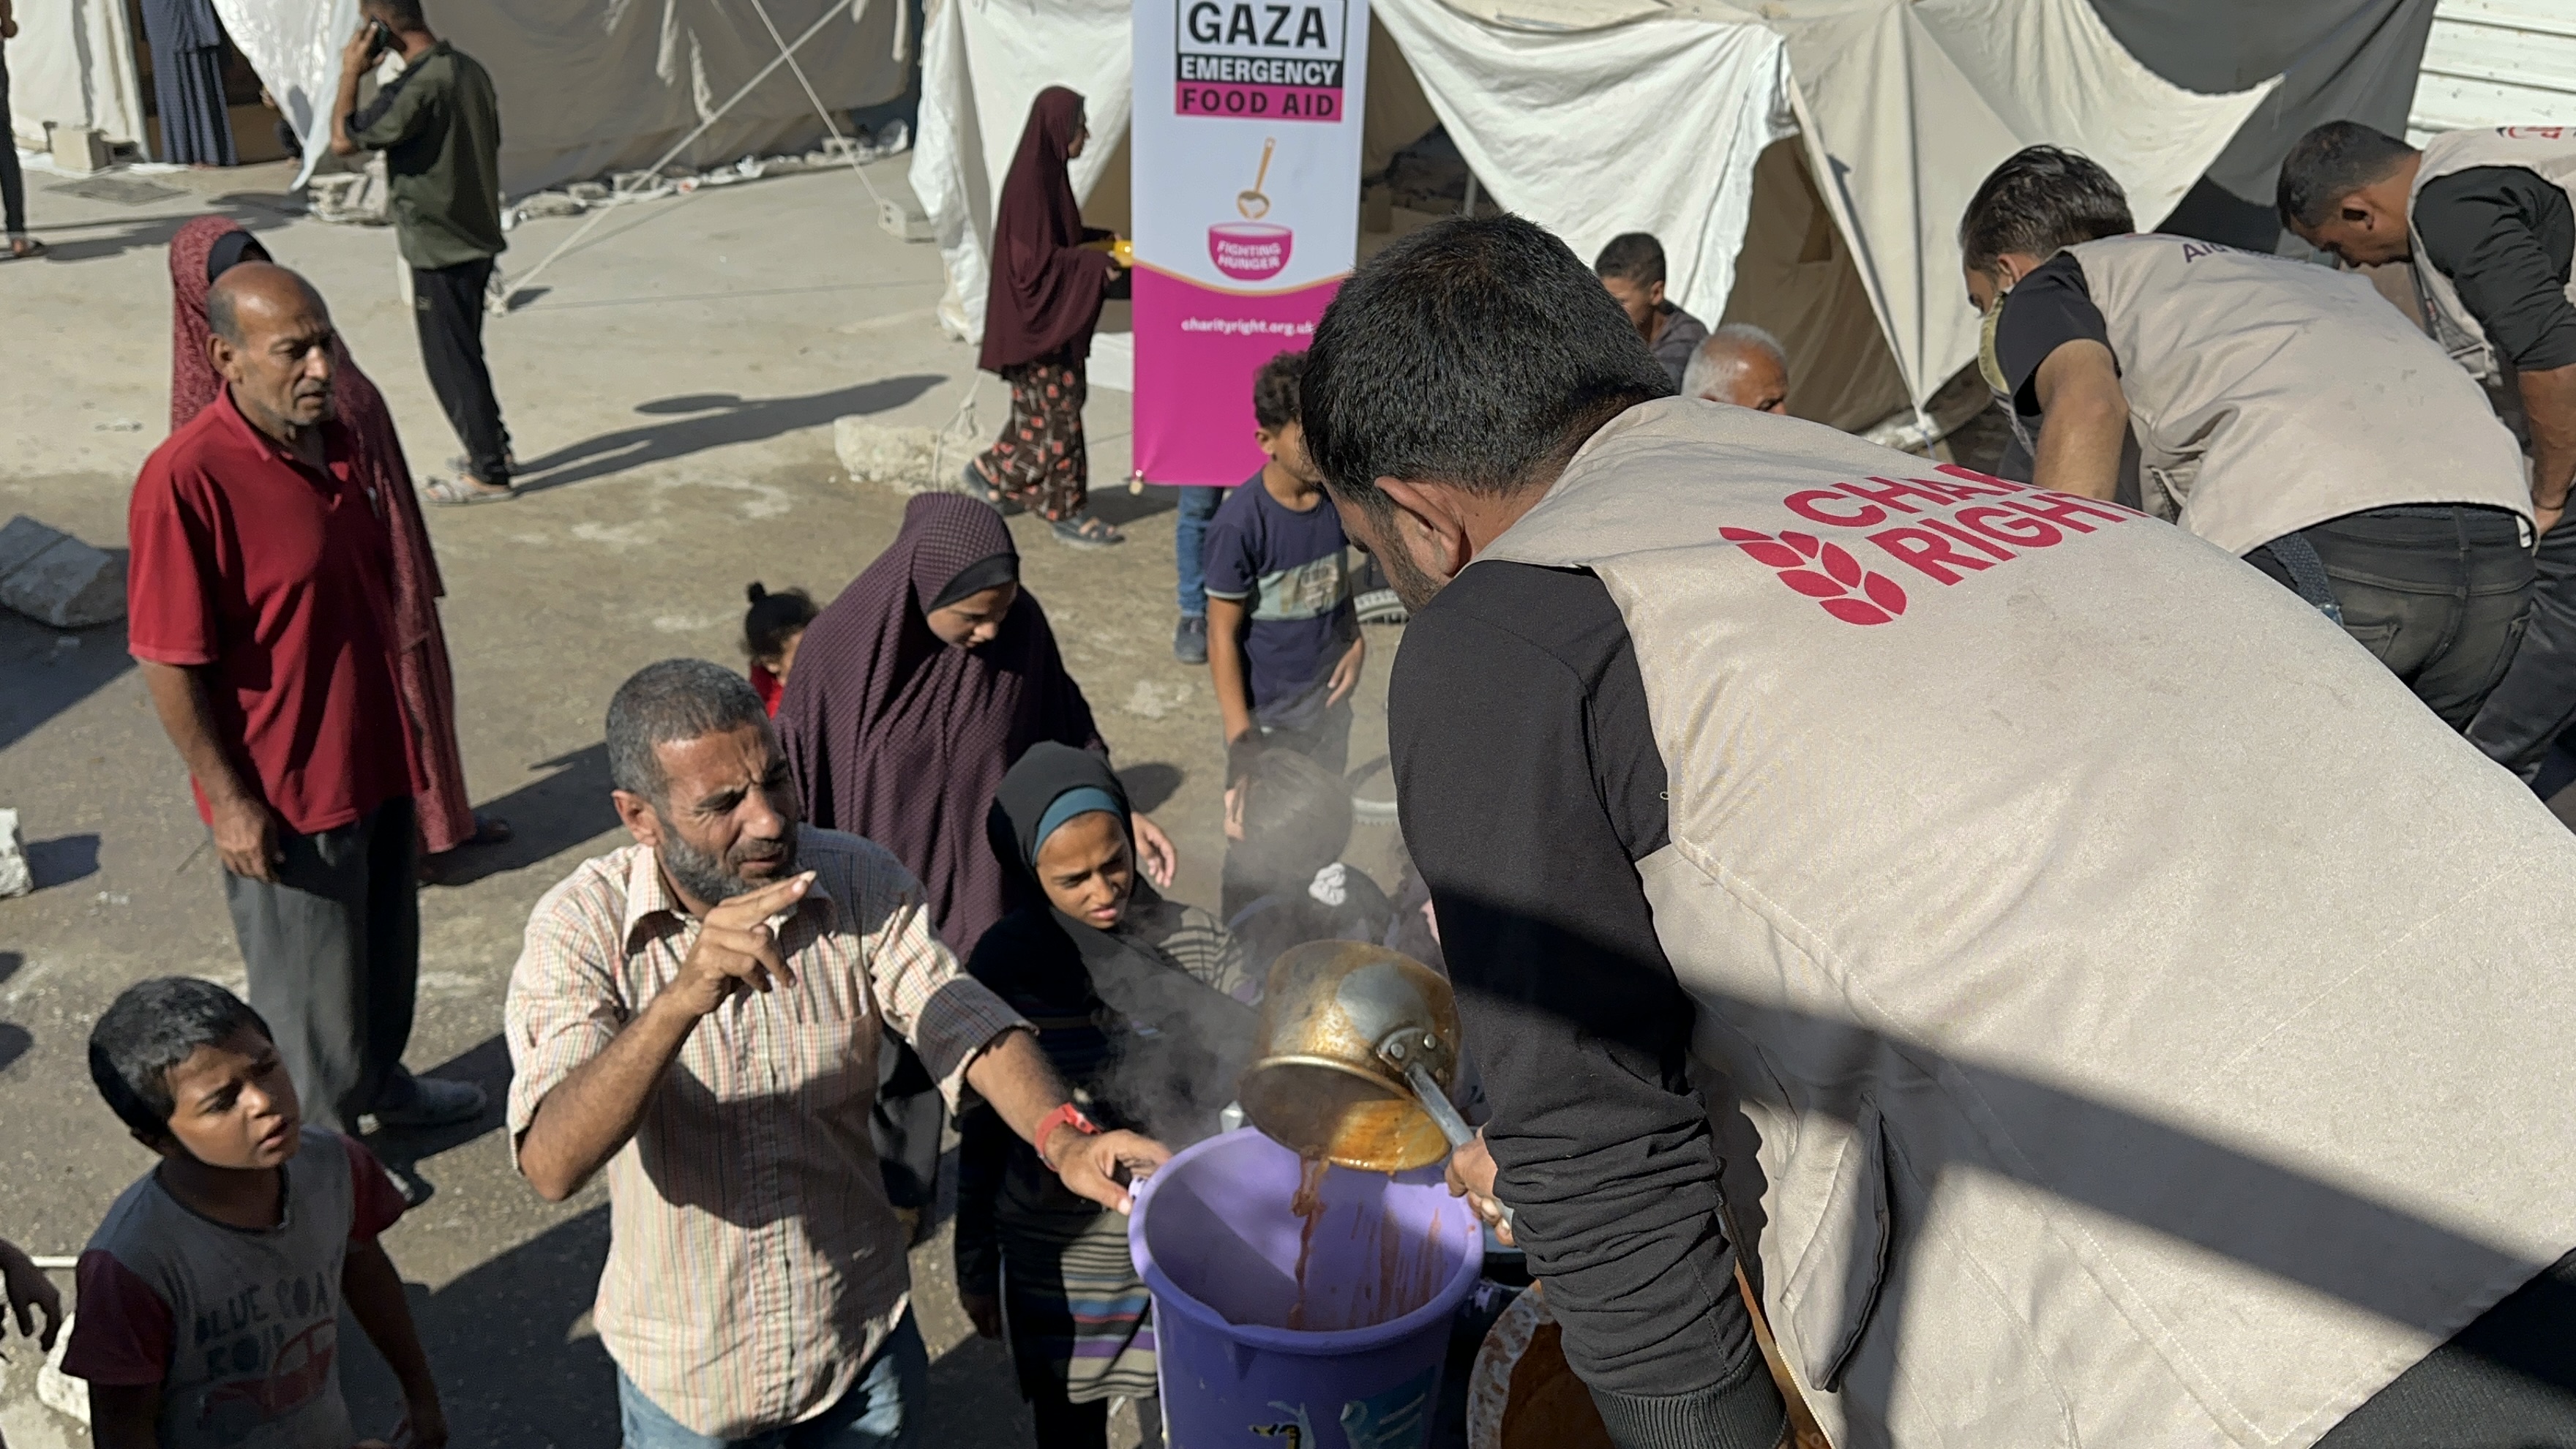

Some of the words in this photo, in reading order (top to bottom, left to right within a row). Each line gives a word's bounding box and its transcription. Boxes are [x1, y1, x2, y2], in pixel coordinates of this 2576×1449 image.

[1187, 1, 1328, 48] GAZA
[1180, 56, 1338, 86] EMERGENCY
[1182, 89, 1268, 113] FOOD
[1281, 93, 1334, 116] AID
[1217, 240, 1281, 256] FIGHTING
[1218, 254, 1280, 270] HUNGER
